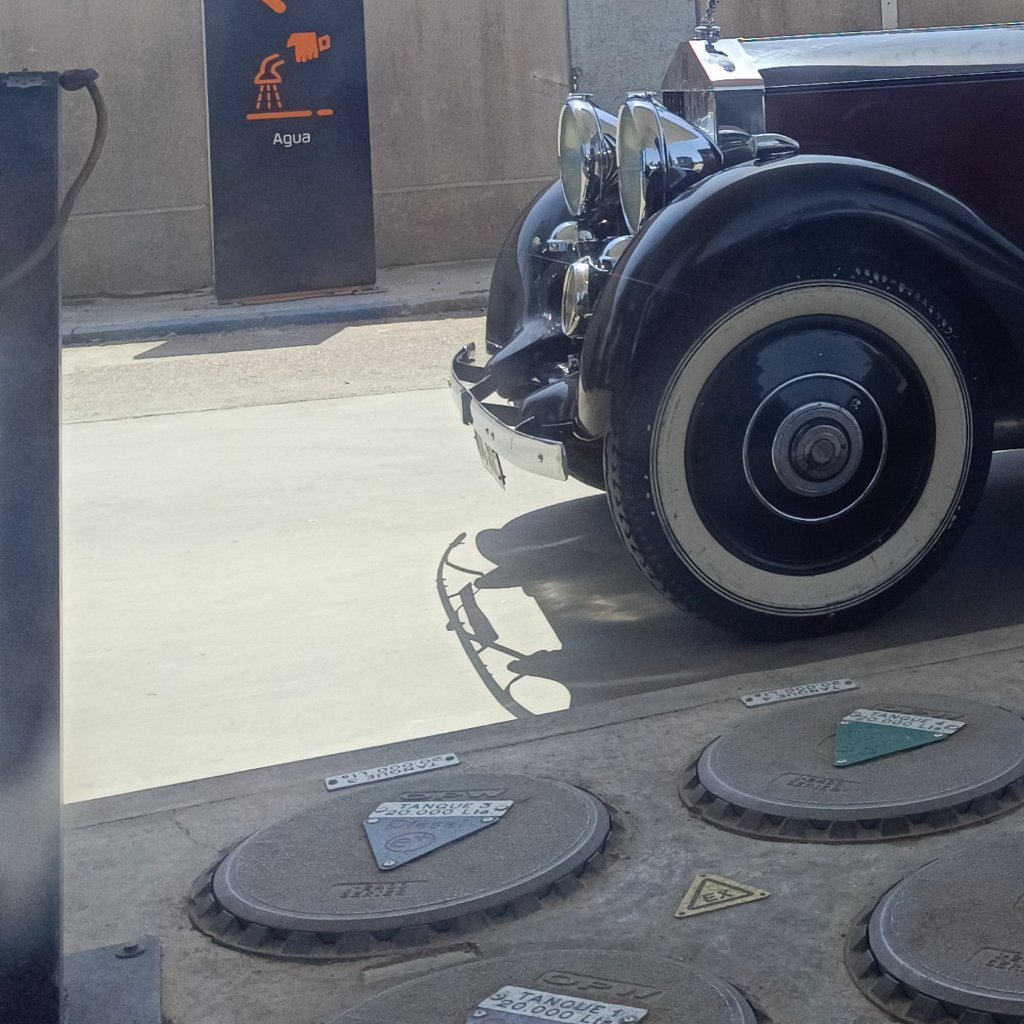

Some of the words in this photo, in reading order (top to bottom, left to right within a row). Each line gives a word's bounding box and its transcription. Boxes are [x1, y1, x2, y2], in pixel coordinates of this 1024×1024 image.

[272, 132, 311, 148] Agua
[857, 715, 913, 727] 20.000
[870, 711, 931, 724] TANQUE
[364, 761, 438, 781] TANQUE
[384, 808, 455, 816] 20.000
[400, 802, 474, 810] TANQUE
[701, 889, 735, 902] EX
[496, 998, 575, 1020] 20.000
[518, 990, 606, 1014] TANQUE
[612, 1007, 625, 1018] 1
